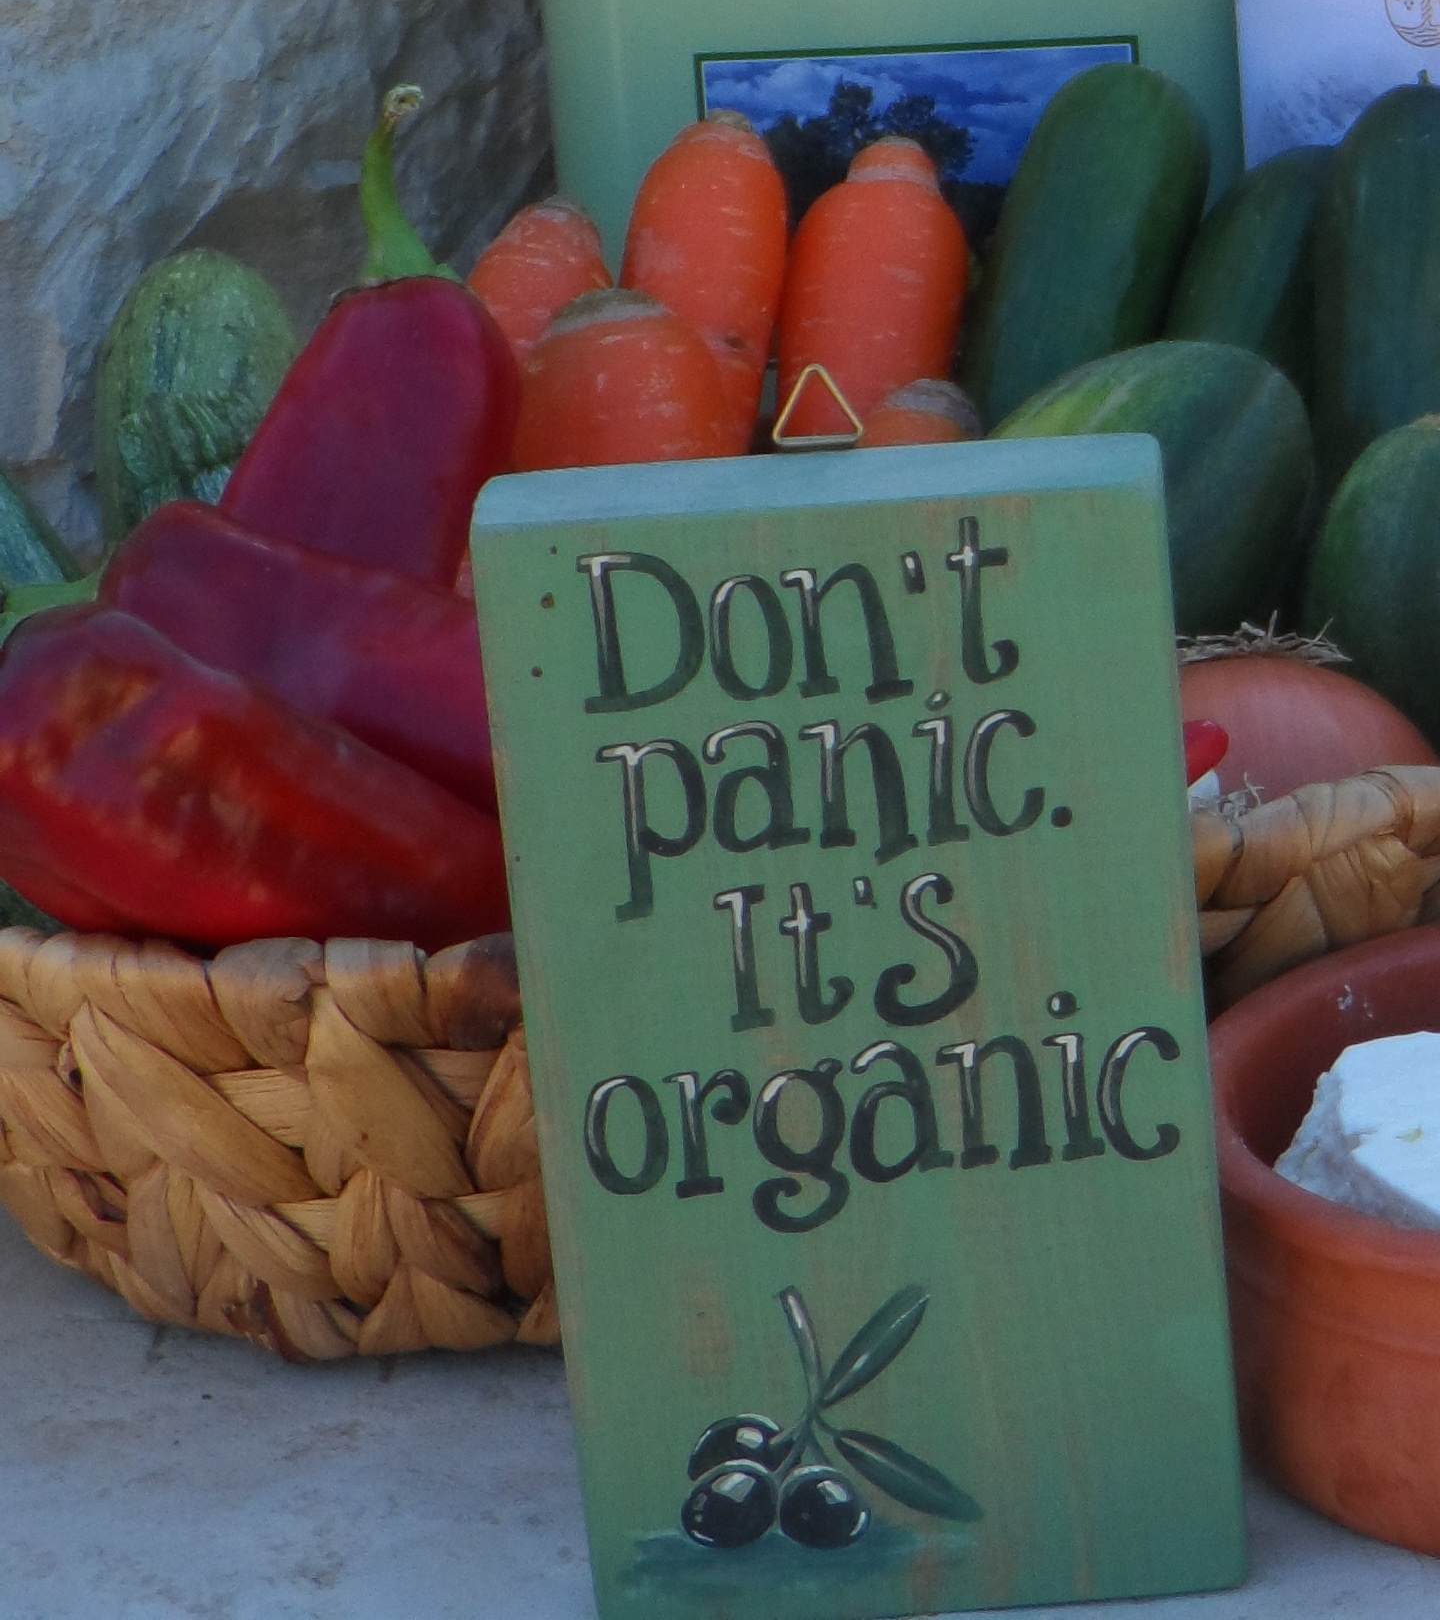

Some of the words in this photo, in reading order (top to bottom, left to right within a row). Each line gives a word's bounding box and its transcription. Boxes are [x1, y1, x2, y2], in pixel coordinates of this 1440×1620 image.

[577, 515, 1020, 713] Don't
[595, 692, 1073, 922] panic.
[583, 993, 1182, 1234] organic
